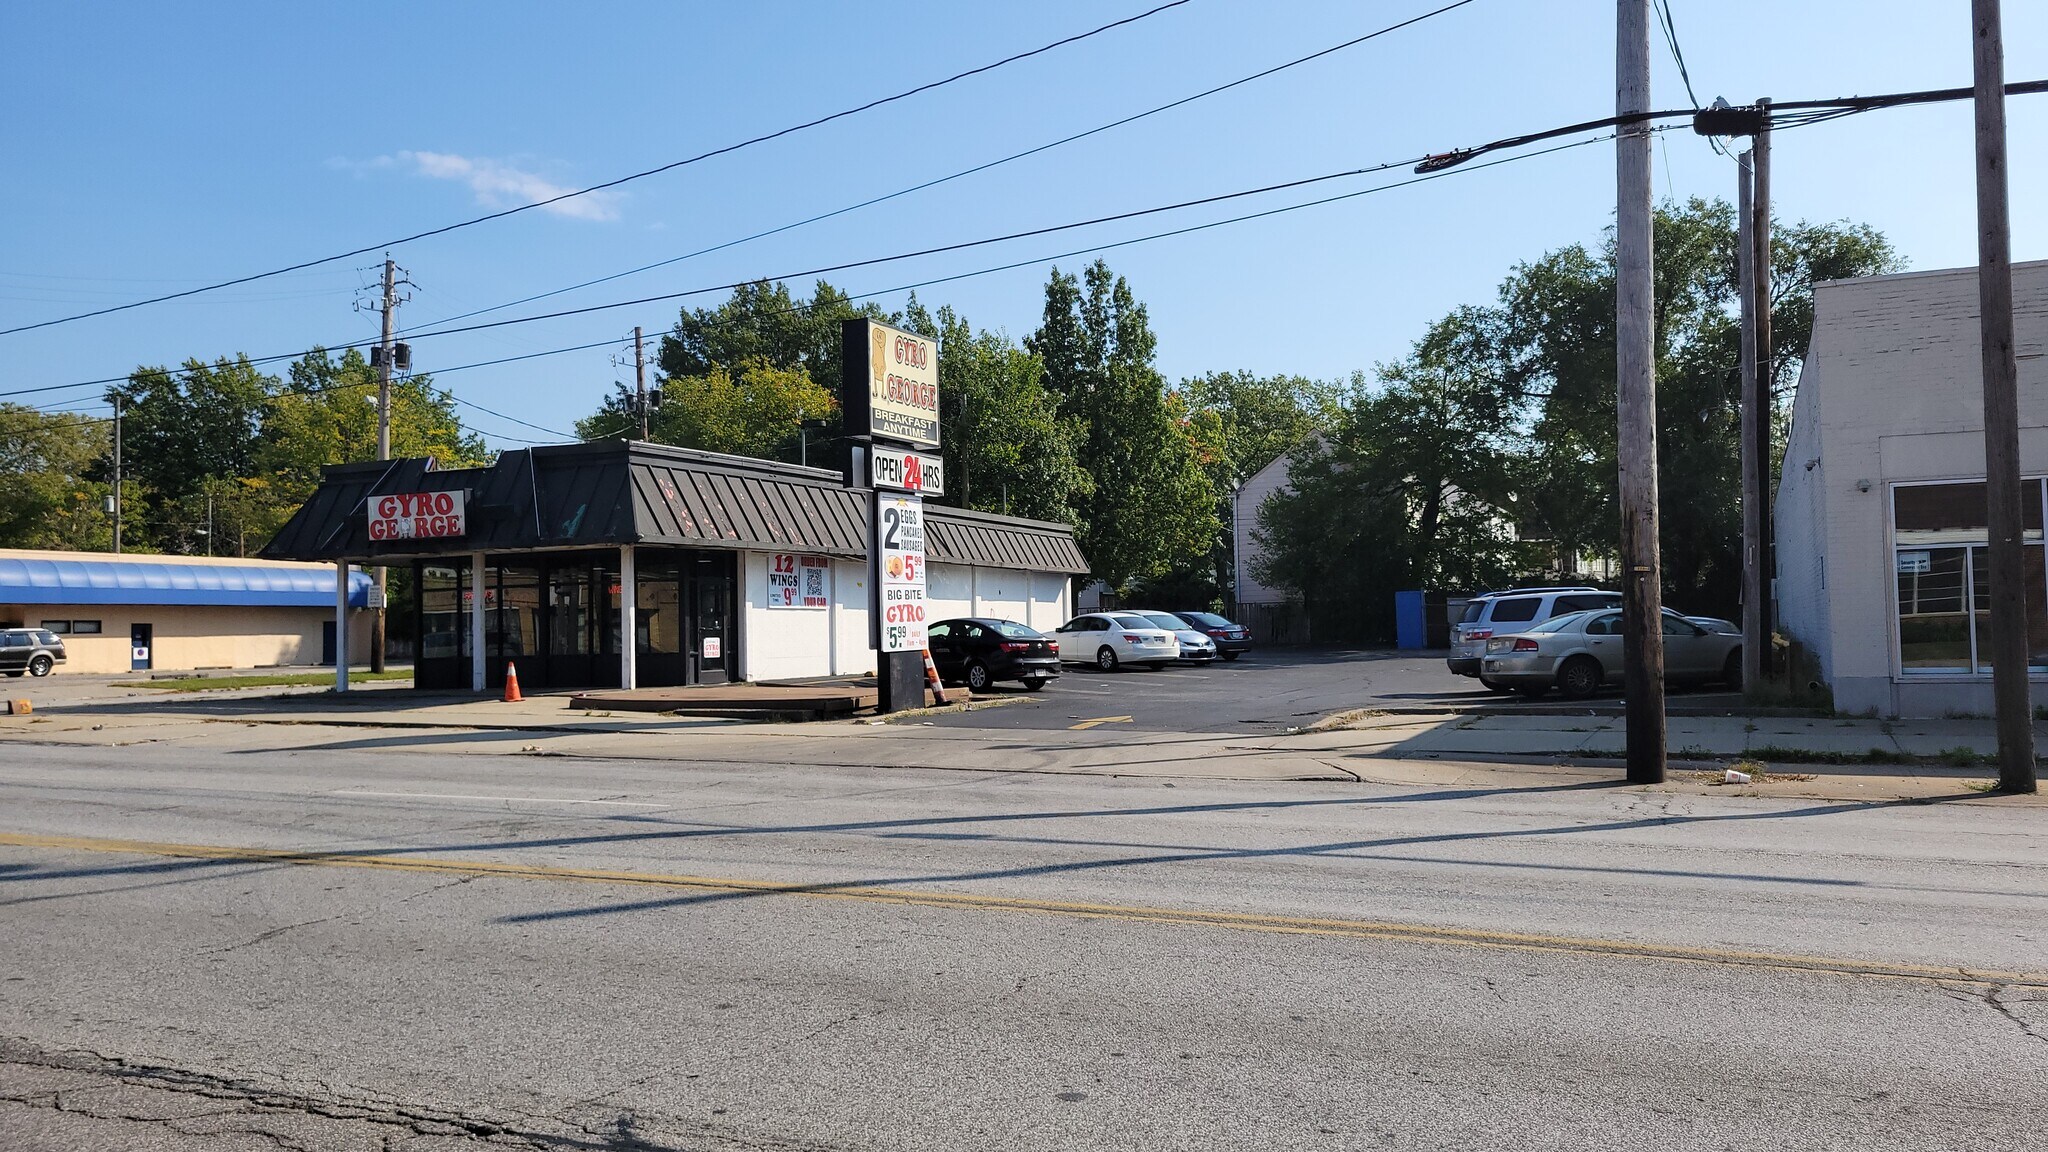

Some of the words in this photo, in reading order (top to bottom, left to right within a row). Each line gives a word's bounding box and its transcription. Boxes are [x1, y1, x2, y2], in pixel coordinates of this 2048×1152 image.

[894, 335, 927, 371] GYRO
[887, 373, 936, 412] GEORGE
[875, 409, 933, 430] BREAKFAST
[883, 422, 927, 439] ANYTIME
[875, 456, 902, 483] OPEN
[904, 455, 922, 491] 24
[922, 464, 940, 489] HRS
[378, 493, 454, 519] GYRO
[900, 509, 917, 525] EGGS
[884, 508, 900, 550] 2
[775, 554, 794, 574] 12
[770, 574, 798, 587] WINGS
[803, 597, 816, 607] YOUR
[816, 597, 827, 607] CAR
[887, 589, 902, 600] BIG
[905, 590, 922, 600] BITE
[886, 604, 926, 623] GYRO
